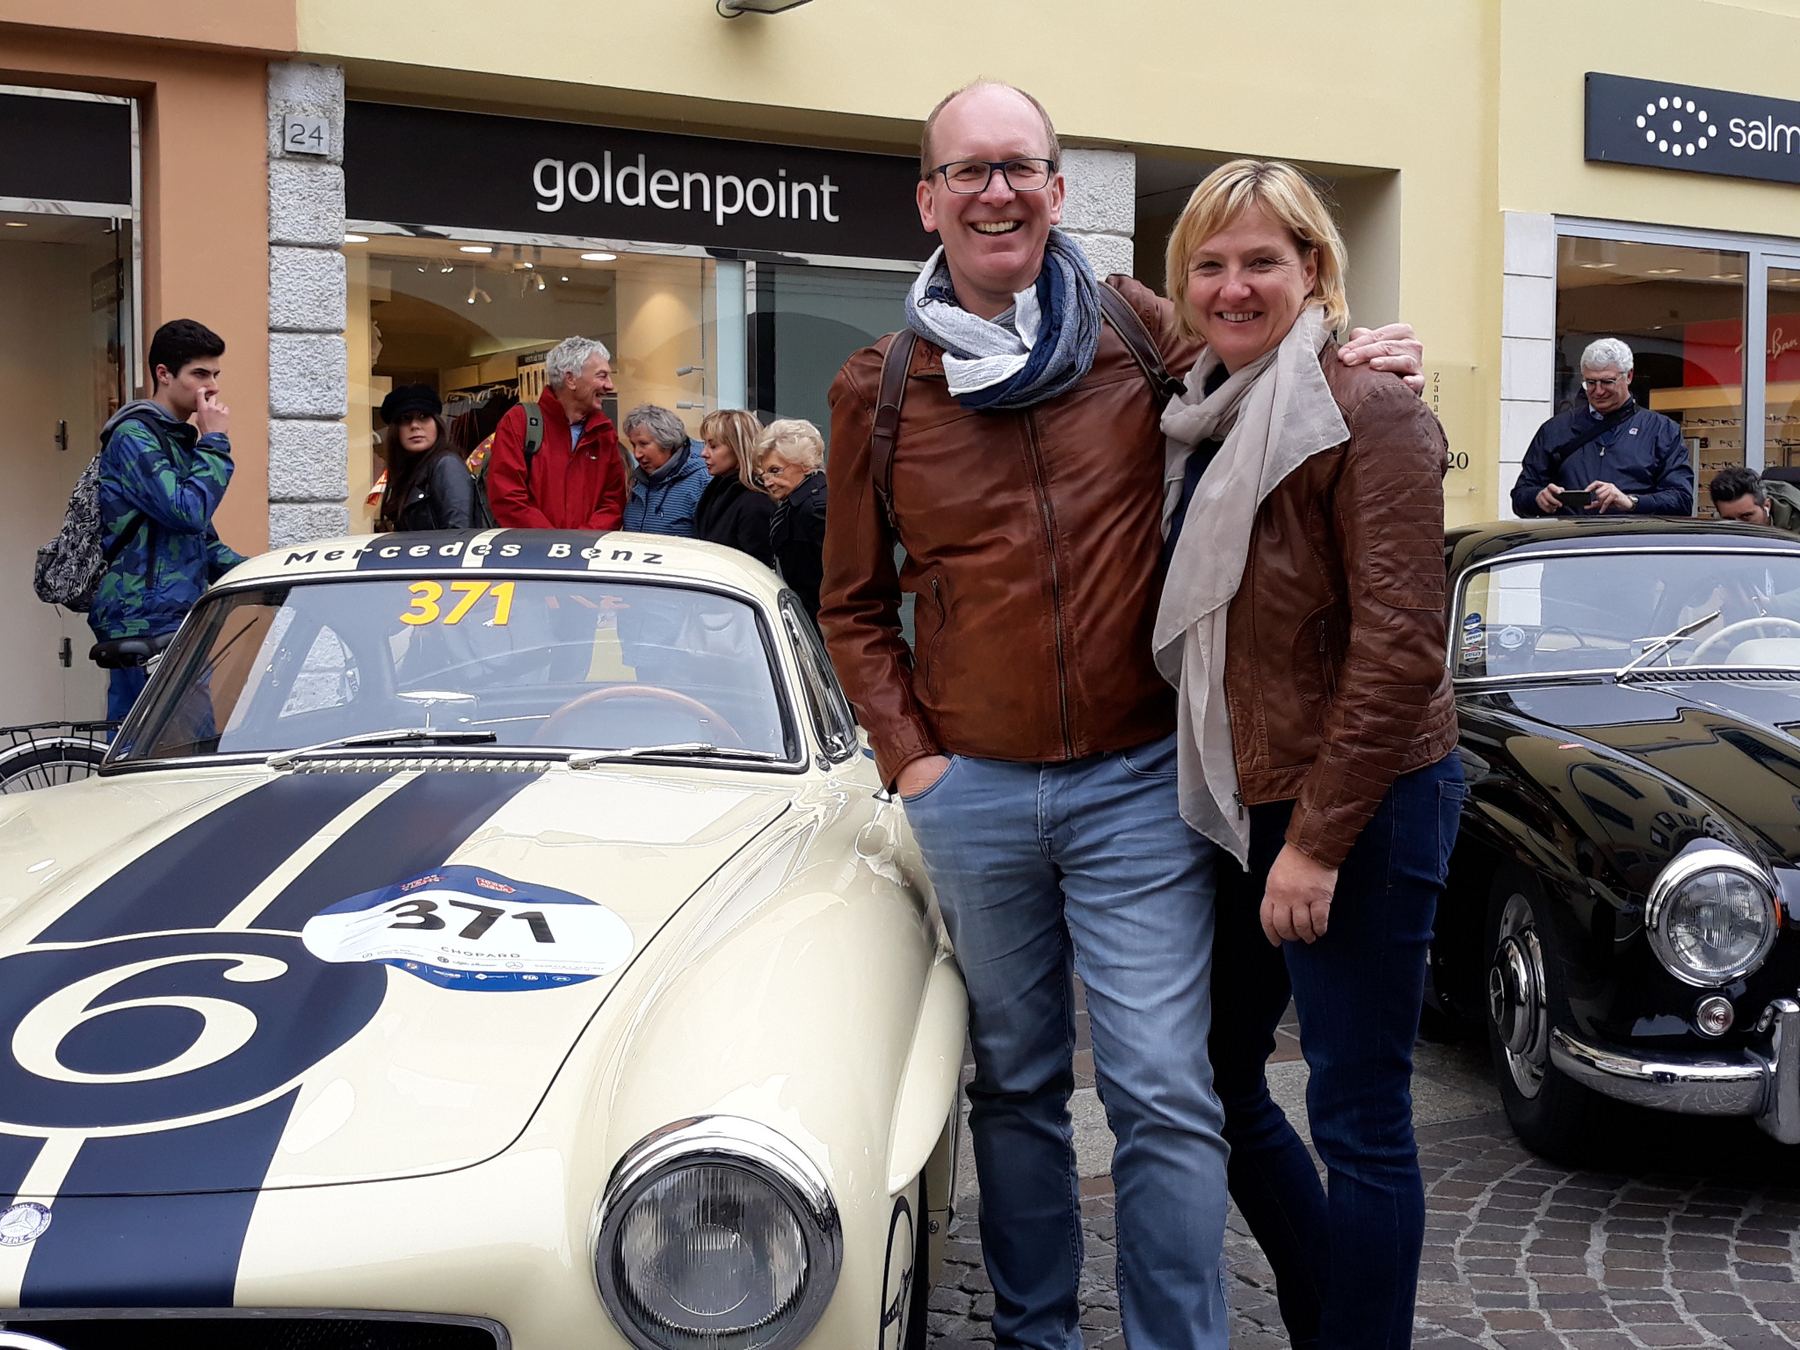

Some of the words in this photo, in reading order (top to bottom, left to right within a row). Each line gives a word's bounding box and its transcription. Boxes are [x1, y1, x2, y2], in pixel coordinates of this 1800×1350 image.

[289, 122, 325, 148] 24
[532, 150, 840, 227] goldenpoint
[283, 541, 522, 567] Mercedes
[548, 542, 664, 566] Benz
[399, 580, 516, 626] 371
[385, 899, 556, 944] 371
[441, 946, 521, 957] CHOPARD
[11, 952, 289, 1084] 6
